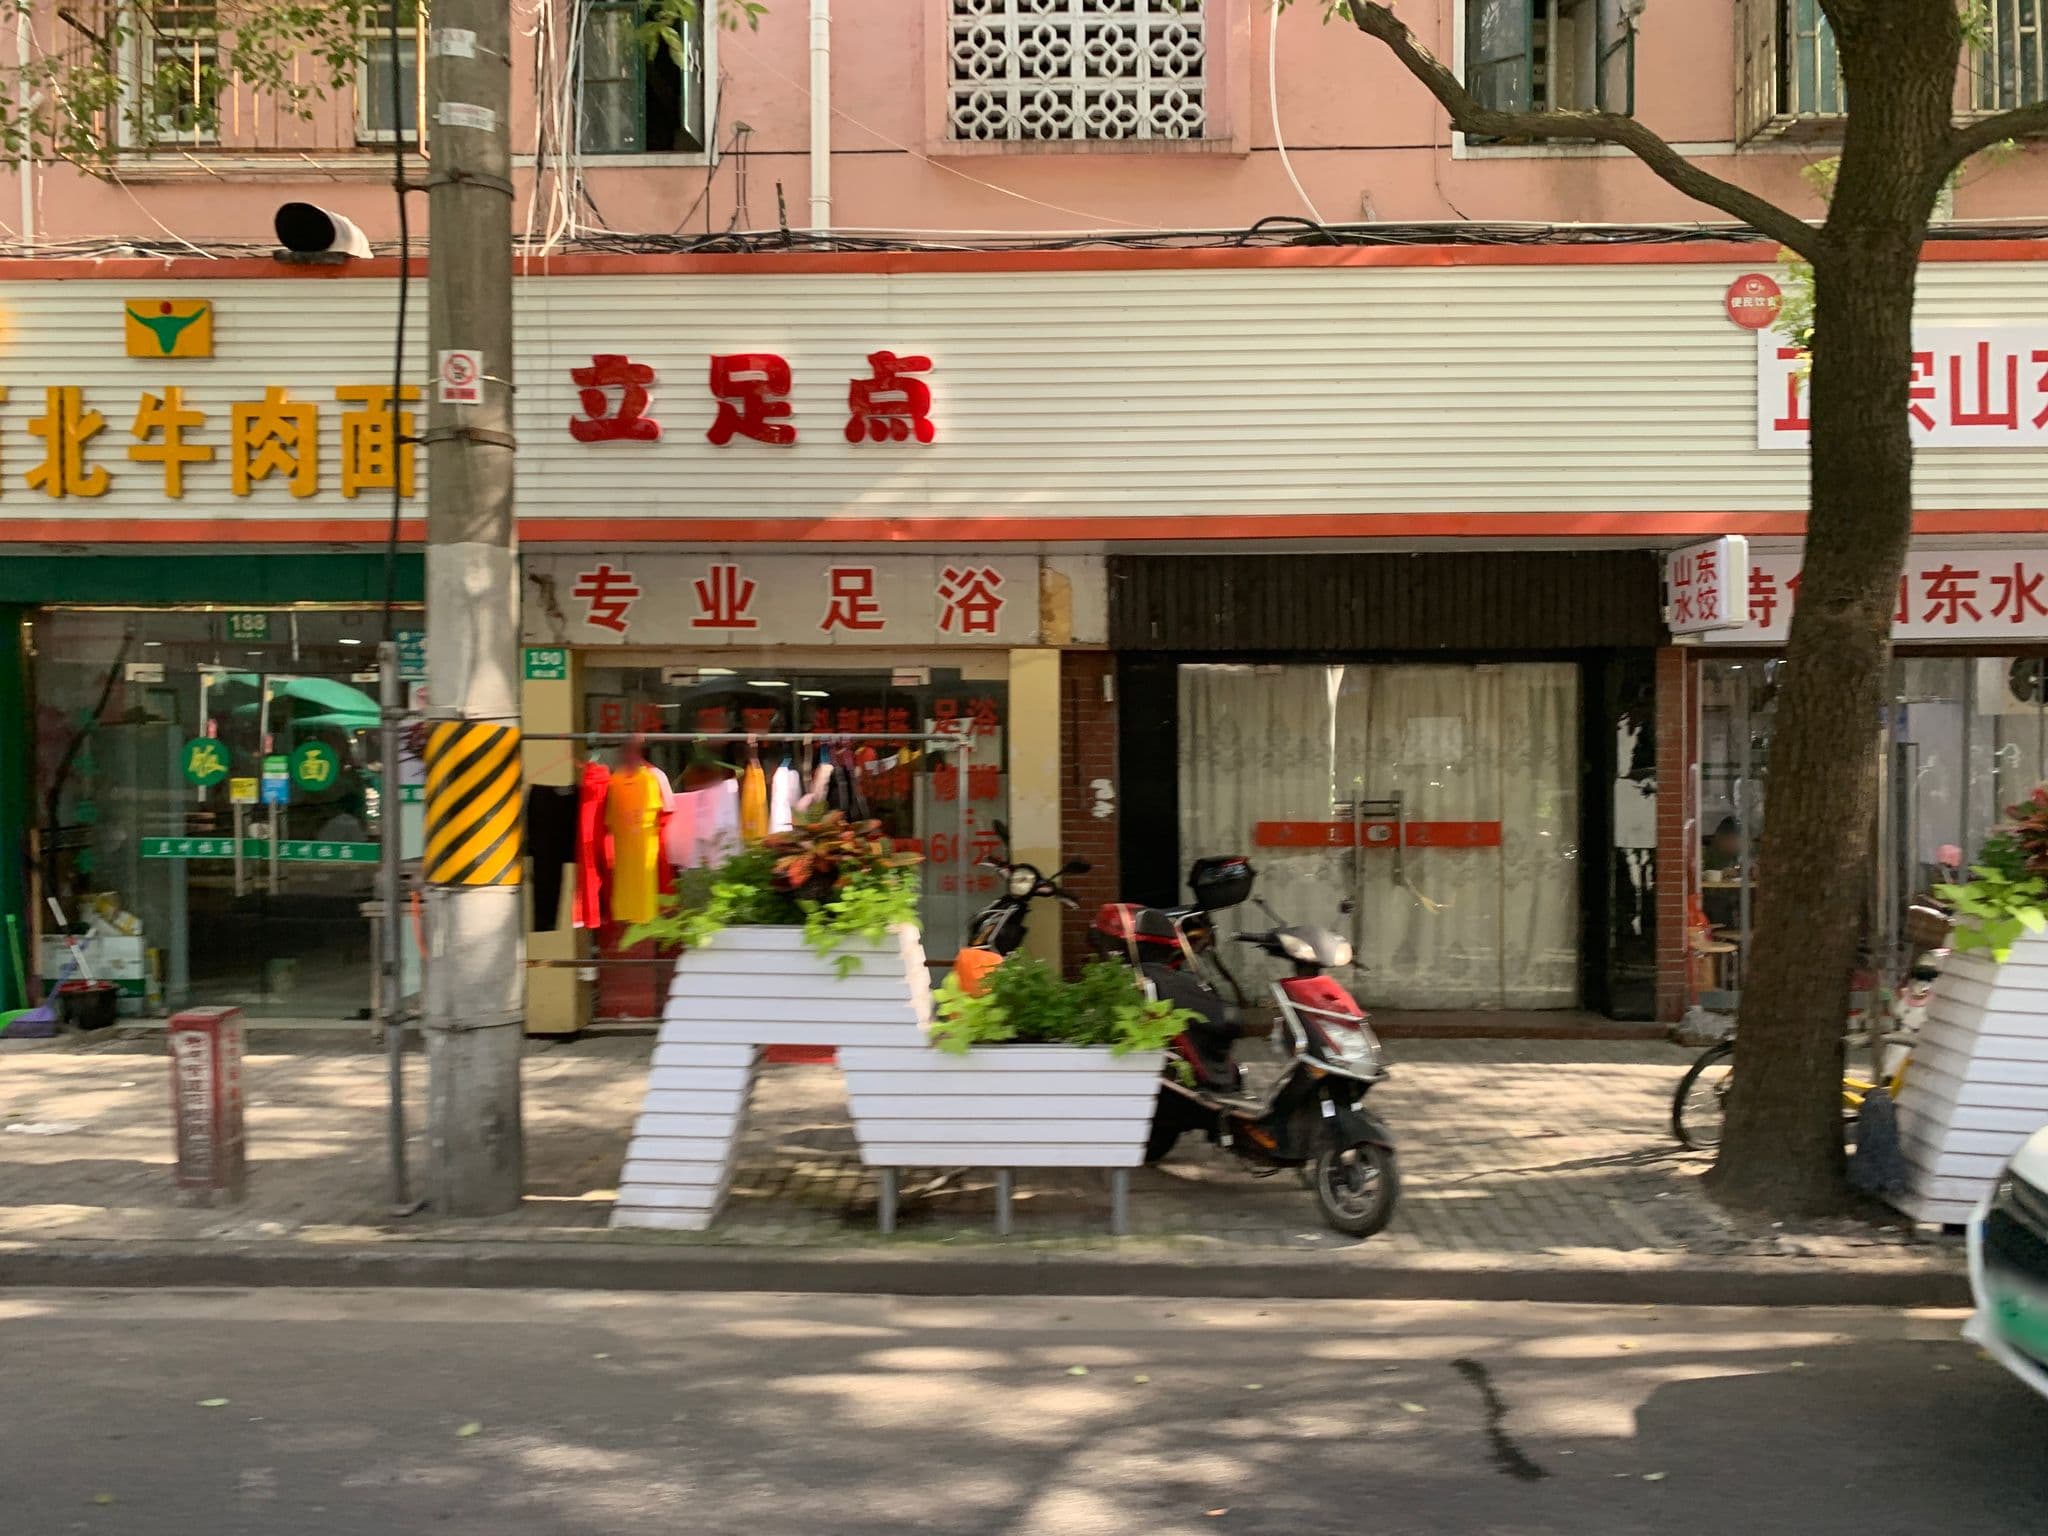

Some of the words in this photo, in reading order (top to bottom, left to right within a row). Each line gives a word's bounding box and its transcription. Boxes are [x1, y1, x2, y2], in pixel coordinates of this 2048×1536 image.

[568, 350, 936, 447] 立足点
[0, 386, 421, 499] 北牛肉面
[1673, 549, 1717, 588] 山东
[571, 564, 1006, 635] 专业足浴
[1673, 586, 1719, 624] 水饺
[530, 651, 562, 665] 190
